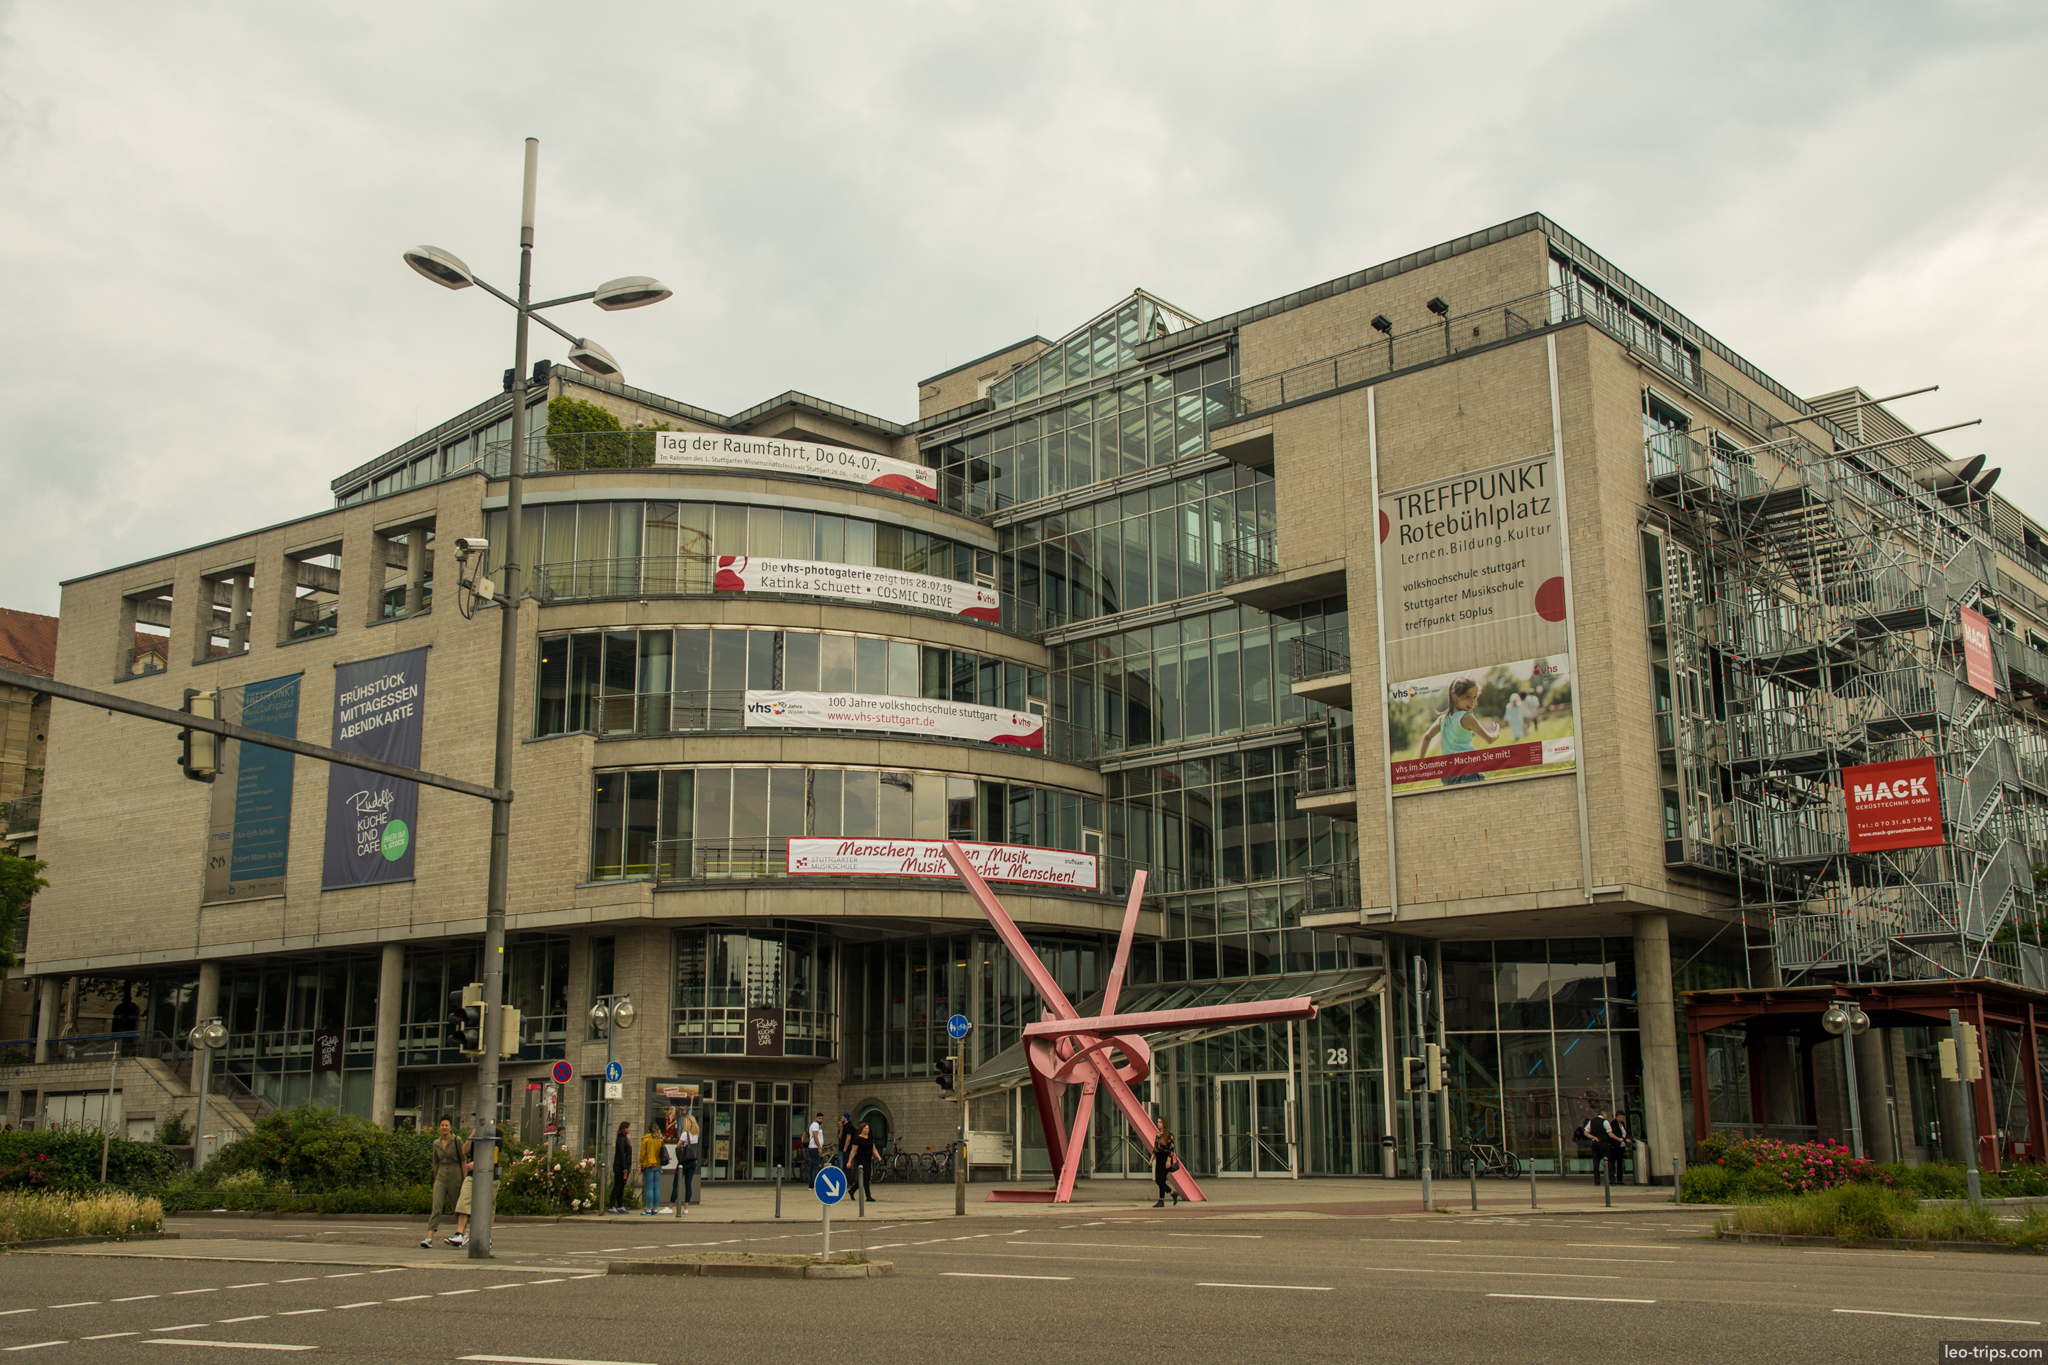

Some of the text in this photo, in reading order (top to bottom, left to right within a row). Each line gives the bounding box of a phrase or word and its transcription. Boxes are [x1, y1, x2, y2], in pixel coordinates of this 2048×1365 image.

[661, 435, 880, 472] Tag der Raumfahrt, Do 04.07.
[806, 466, 830, 474] Stuttgart
[1394, 462, 1548, 520] TREFFPUNKT
[1400, 497, 1551, 545] Rotebühlplatz
[1402, 523, 1552, 565] Lernen.Bildung.Kultur
[761, 562, 953, 593] Die vhs-photogalerie zeigt bis 28.07.19
[1402, 558, 1526, 592] volkshochschule stuttgart
[761, 576, 953, 608] Katinka Schuett COSMIC DRIVE
[982, 595, 996, 605] vhs
[1404, 579, 1524, 611] Stuttgarter Musikschule
[1405, 606, 1493, 631] treffpunkt 50plus
[1964, 624, 1988, 652] MACK
[1541, 665, 1558, 674] vhs
[246, 686, 295, 704] TREFFPUNKT
[340, 672, 405, 706] FRÜHSTÜCK
[1392, 690, 1408, 699] vhs
[340, 684, 418, 723] MITTAGESSEN
[748, 702, 771, 713] vhs
[828, 697, 998, 722] 100 Jahre volkshochschule stuttgart
[340, 703, 413, 740] ABENDKARTE
[827, 712, 935, 727] www.vhs-stuttgart.de
[1018, 718, 1031, 727] vhs
[1419, 760, 1447, 770] Sommer
[1454, 756, 1480, 765] Machen
[1482, 753, 1494, 761] Sie
[1495, 750, 1511, 759] mit!
[1854, 777, 1929, 803] MACK
[346, 789, 394, 816] Rudolfs
[1855, 800, 1909, 810] GERÜSTTECHNIK
[357, 812, 387, 831] KÜCHE
[211, 832, 231, 841] mes
[357, 829, 378, 844] UND
[384, 833, 397, 843] HIER
[389, 839, 405, 849] STOCK
[836, 841, 1032, 865] Menschen maen Musik.
[900, 858, 946, 873] Musik
[1007, 864, 1076, 883] Menschen!
[1327, 1048, 1348, 1065] 28
